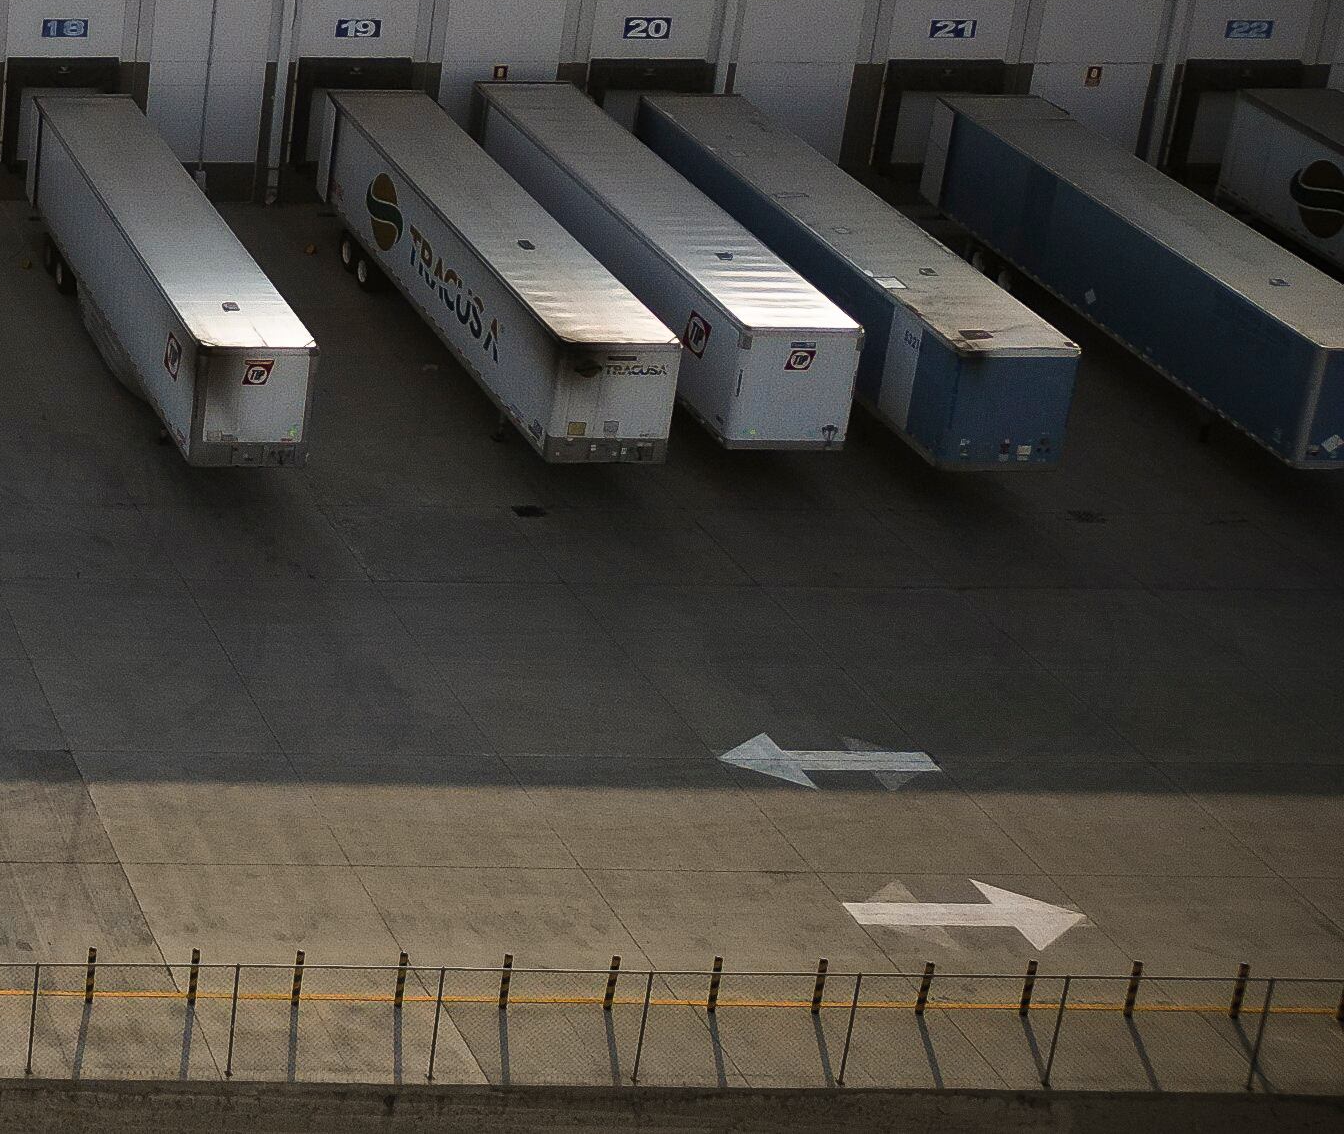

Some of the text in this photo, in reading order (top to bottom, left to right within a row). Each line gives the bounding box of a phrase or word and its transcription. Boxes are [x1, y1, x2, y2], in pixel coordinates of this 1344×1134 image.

[47, 20, 84, 36] 18
[341, 20, 376, 36] 19
[626, 19, 668, 37] 20
[933, 20, 974, 38] 21
[1228, 21, 1268, 38] 22
[410, 225, 499, 363] TRACUSA
[689, 321, 705, 347] TIP
[605, 364, 667, 375] TRACUSA
